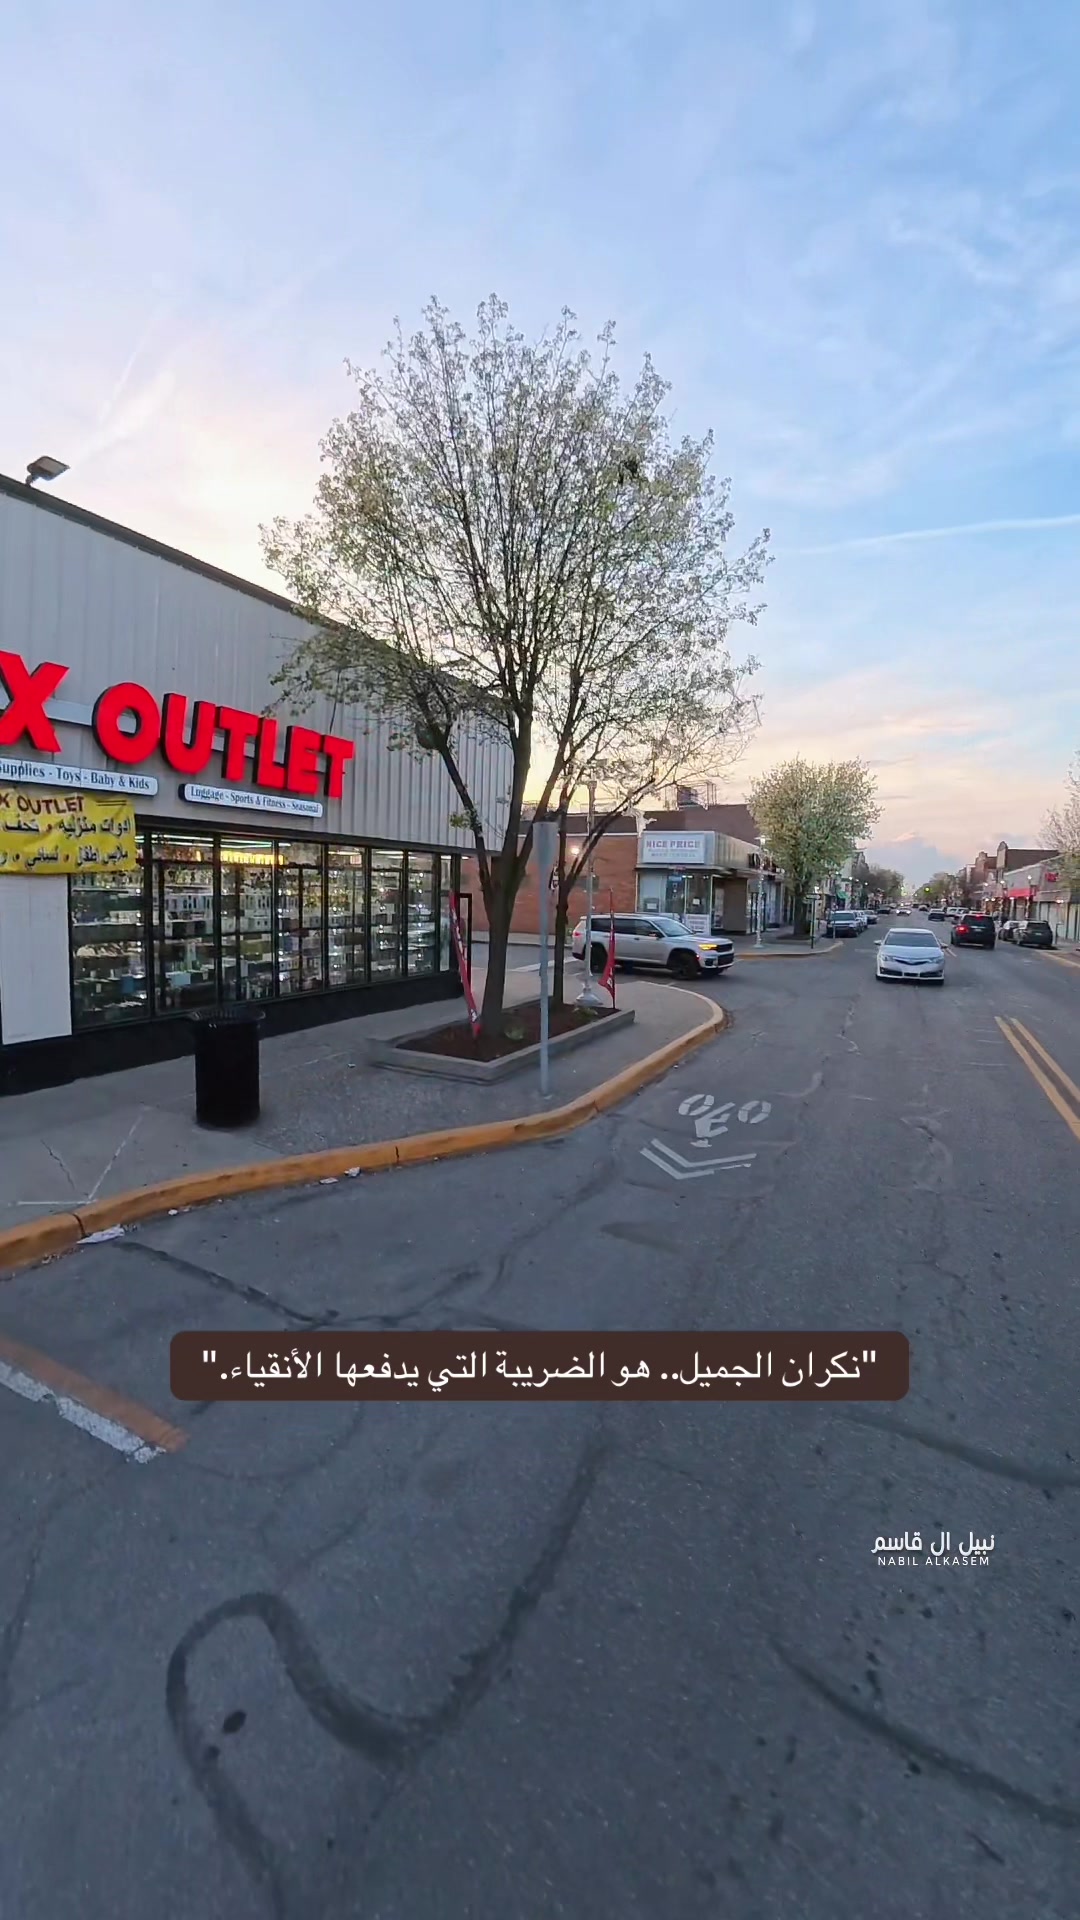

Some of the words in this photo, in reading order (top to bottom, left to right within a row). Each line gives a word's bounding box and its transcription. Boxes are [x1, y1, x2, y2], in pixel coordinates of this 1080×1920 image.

[94, 682, 355, 799] OUTLET
[56, 767, 81, 783] Toys
[91, 772, 115, 787] Baby
[118, 777, 126, 787] &
[129, 777, 150, 790] Kids
[17, 794, 85, 815] OUTLET
[191, 785, 224, 800] Luggage
[230, 791, 254, 805] Sports
[262, 796, 286, 809] Fitness
[292, 802, 319, 813] Seasonal
[646, 840, 668, 849] NICE
[670, 840, 700, 849] PRICE
